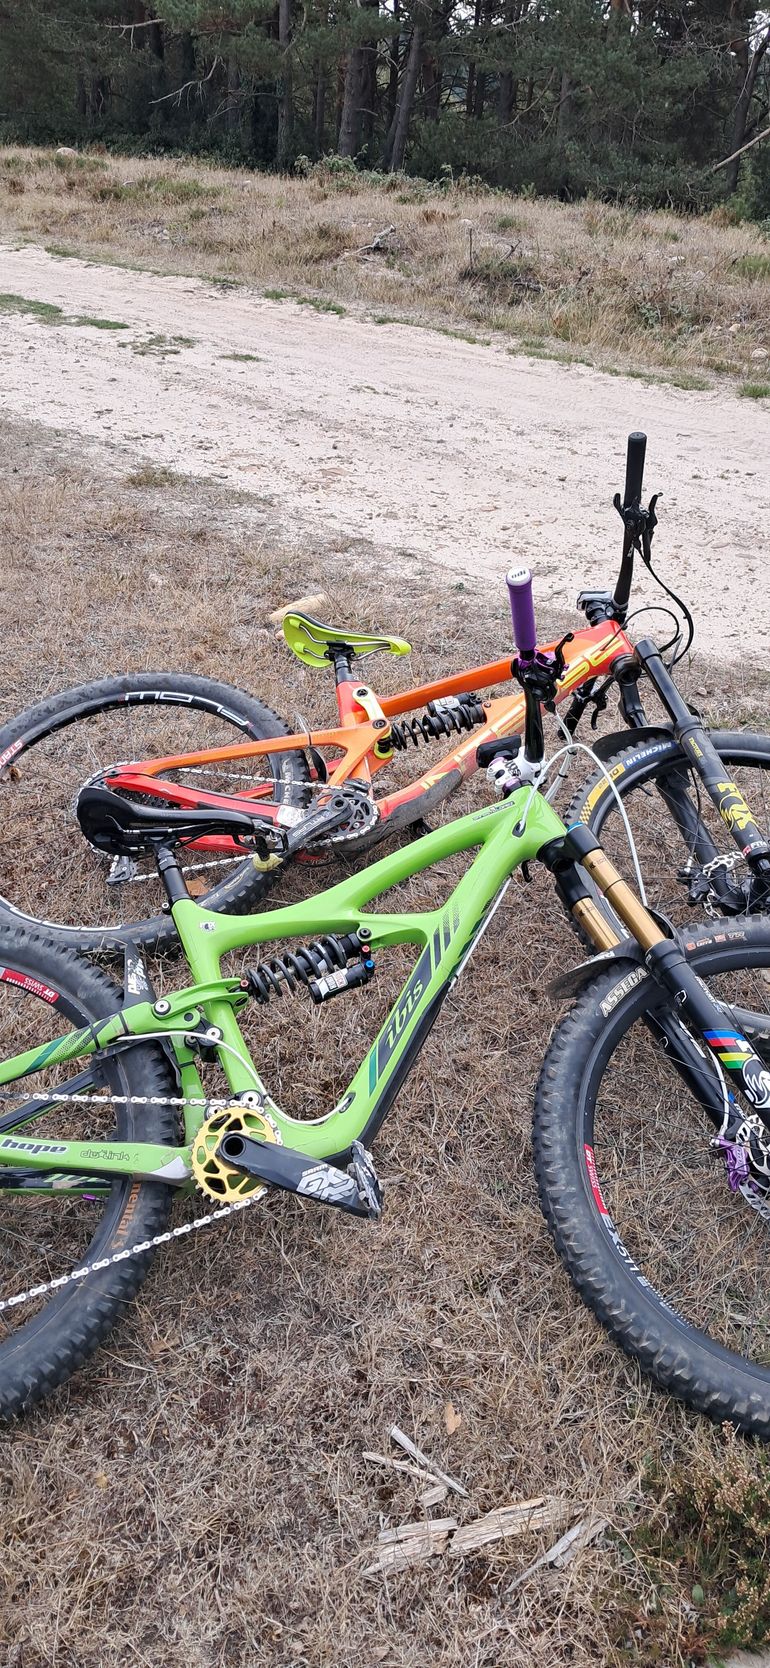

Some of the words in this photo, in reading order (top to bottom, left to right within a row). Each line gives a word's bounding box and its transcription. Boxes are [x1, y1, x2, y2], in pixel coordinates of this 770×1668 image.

[511, 570, 527, 579] odi
[625, 741, 673, 767] MICHELIN
[24, 977, 44, 991] SWISS
[599, 965, 650, 1018] ASSEGA
[384, 978, 424, 1049] ibis
[1, 1138, 68, 1155] hope
[301, 1163, 329, 1178] SRAM
[588, 1164, 600, 1188] SWISS
